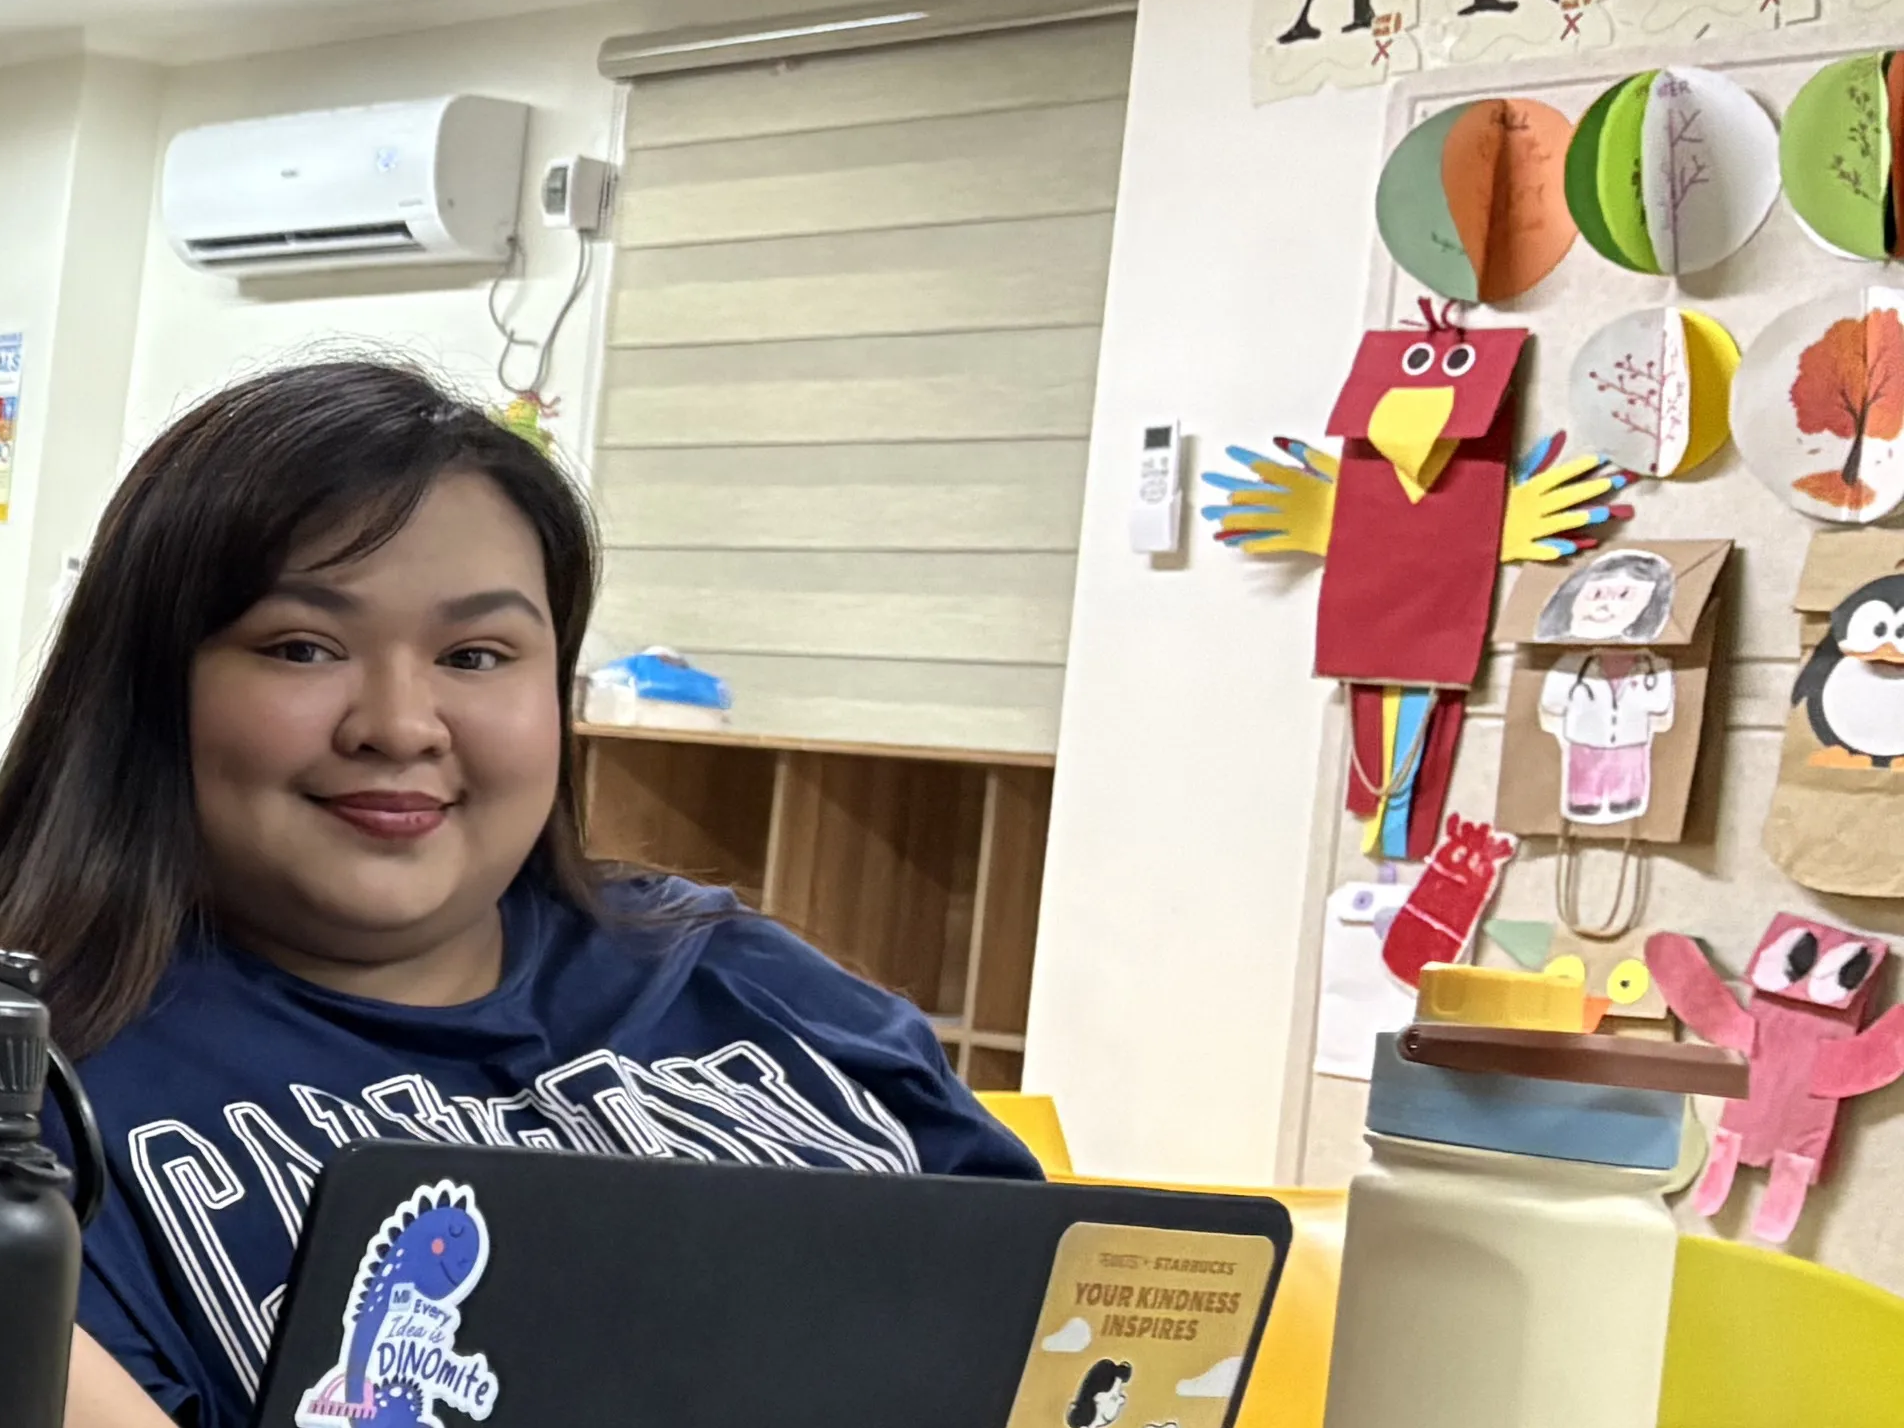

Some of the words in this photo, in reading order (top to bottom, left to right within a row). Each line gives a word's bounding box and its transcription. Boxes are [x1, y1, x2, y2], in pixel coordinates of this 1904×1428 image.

[1152, 1256, 1238, 1276] STARBUCKS
[413, 1298, 452, 1328] Every
[1073, 1281, 1135, 1309] YOUR
[1135, 1286, 1242, 1315] KINDNESS
[384, 1314, 427, 1339] Idea
[428, 1327, 447, 1344] is
[1099, 1313, 1200, 1342] INSPIRES
